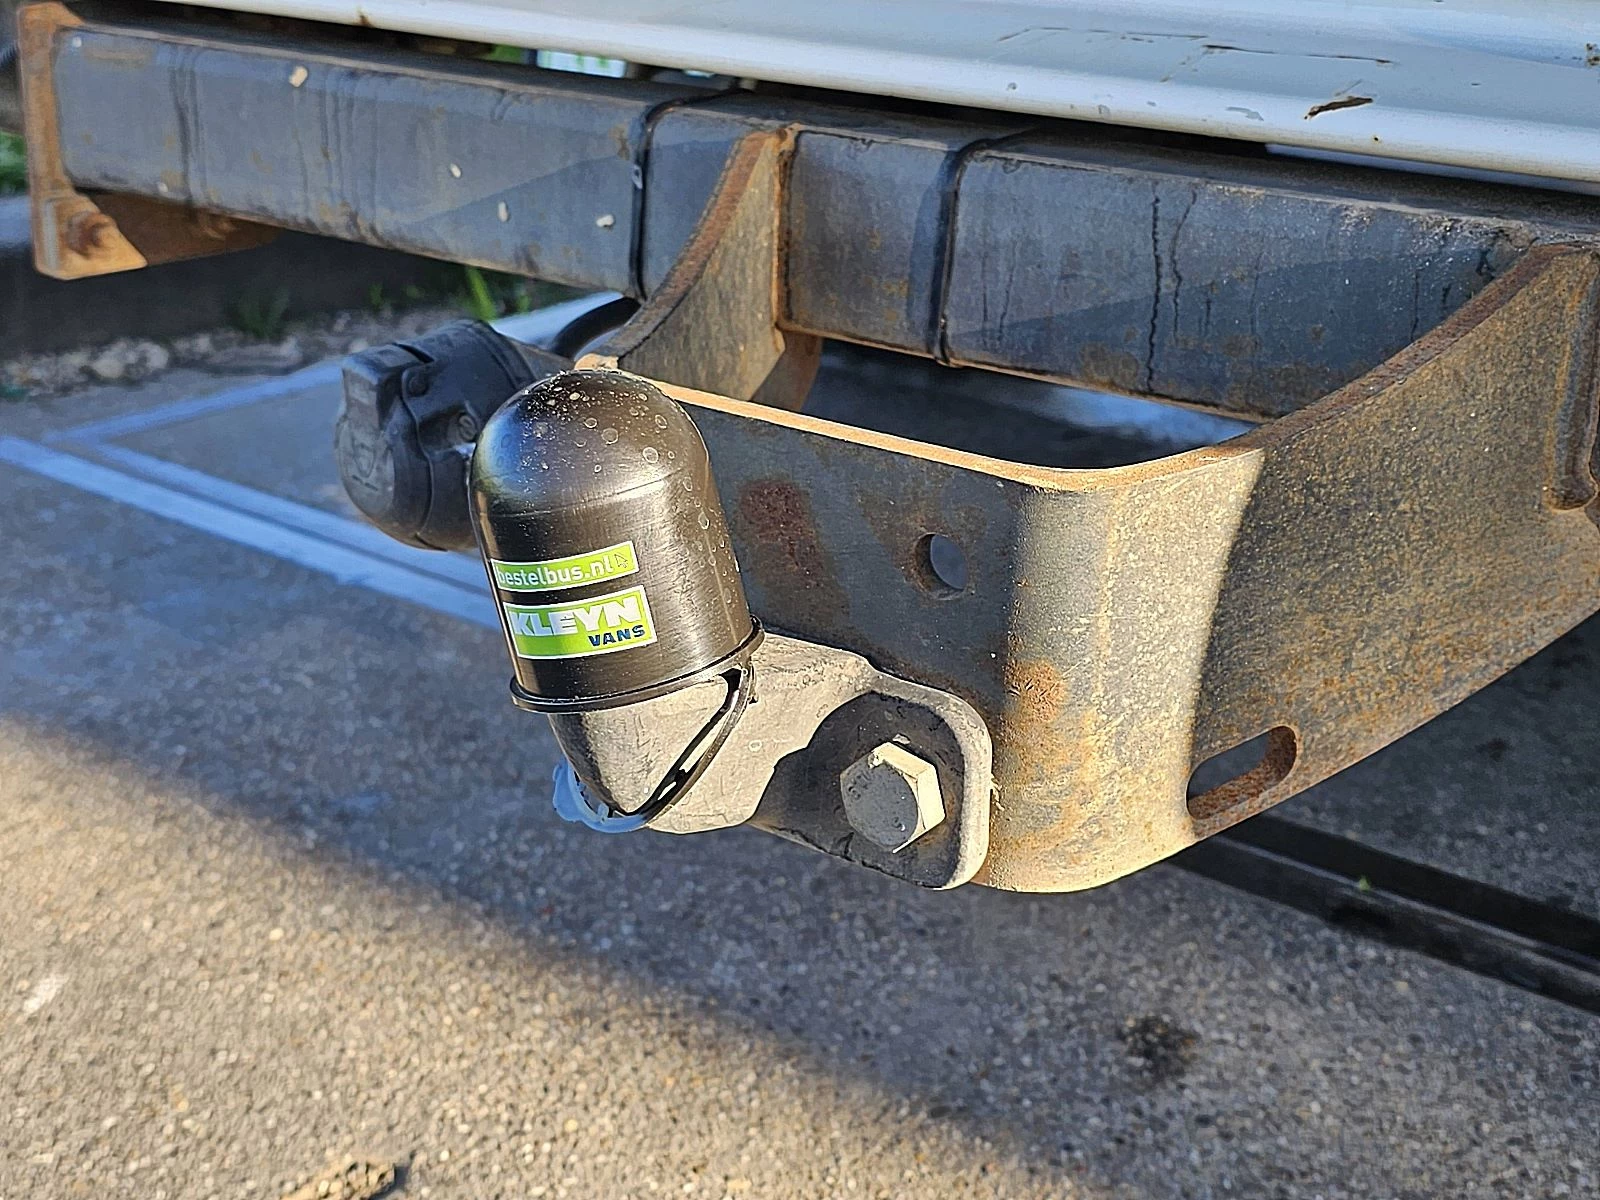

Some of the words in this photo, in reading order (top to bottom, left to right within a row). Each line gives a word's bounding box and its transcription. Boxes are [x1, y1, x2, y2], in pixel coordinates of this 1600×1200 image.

[496, 555, 613, 586] bestelbus.nl
[508, 596, 642, 635] KLEYN
[588, 625, 646, 646] VANS
